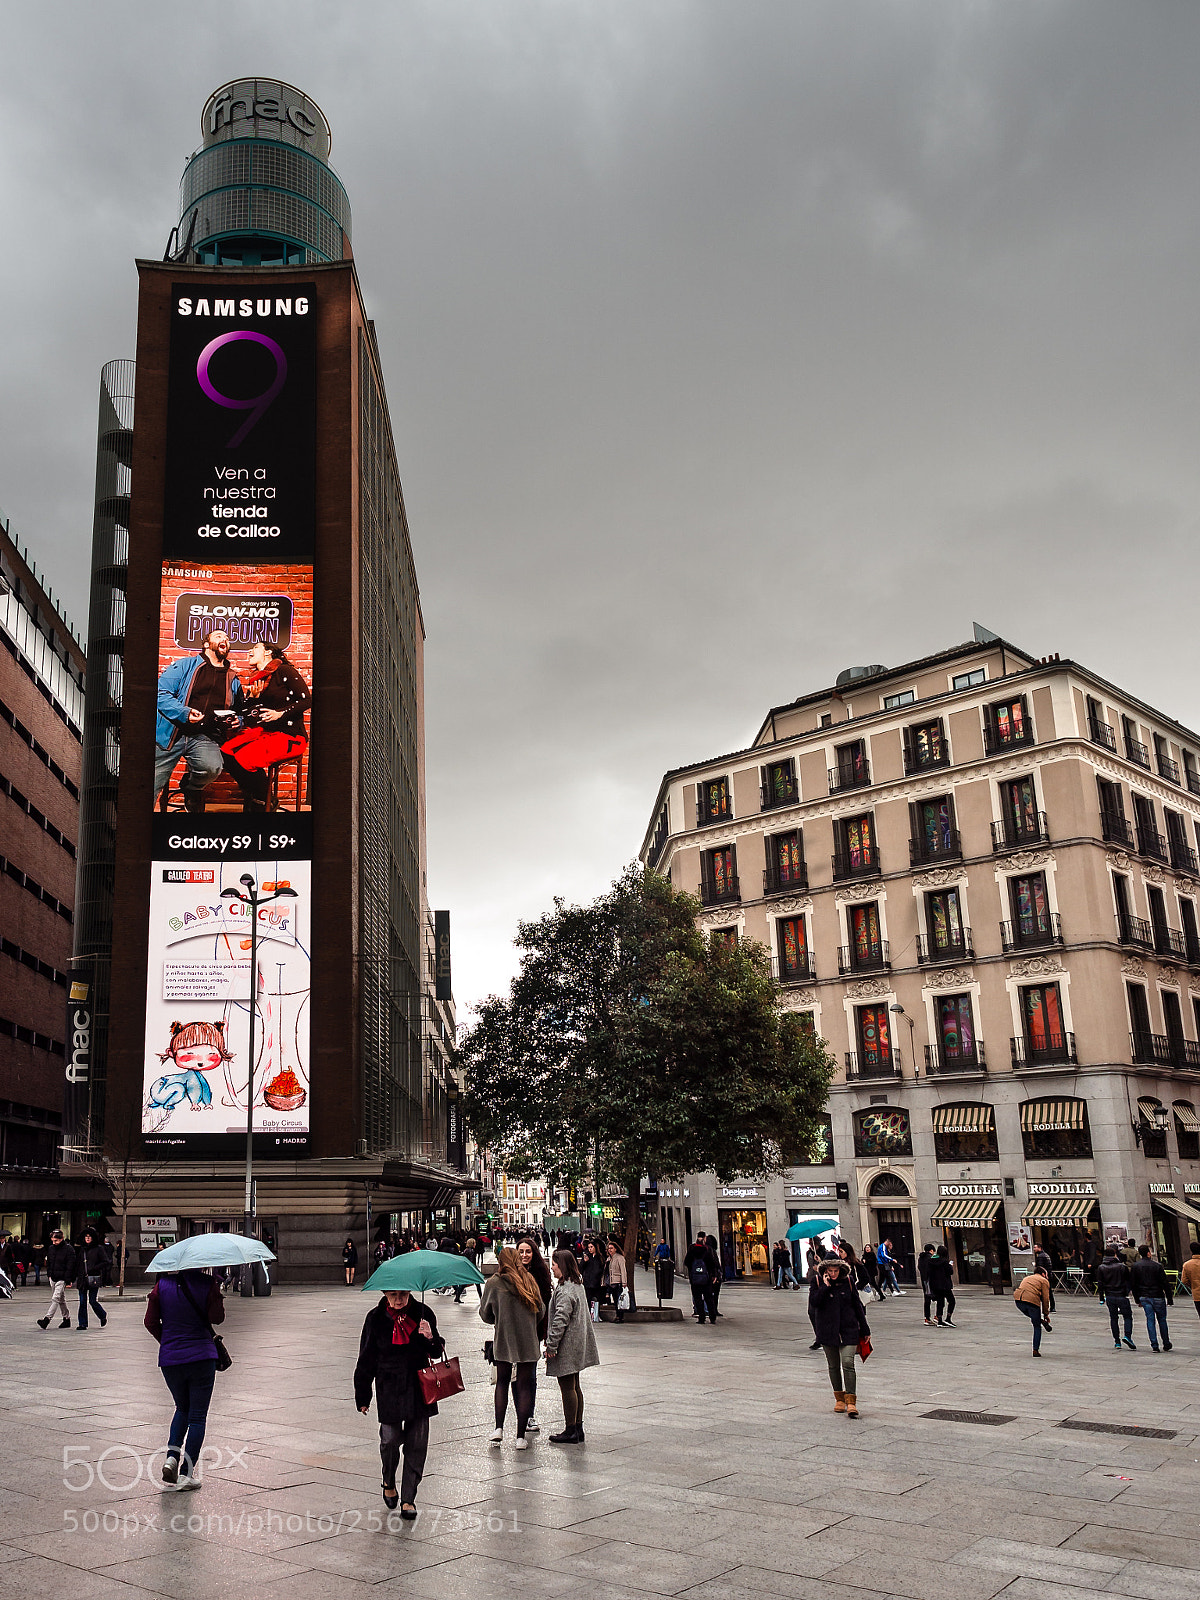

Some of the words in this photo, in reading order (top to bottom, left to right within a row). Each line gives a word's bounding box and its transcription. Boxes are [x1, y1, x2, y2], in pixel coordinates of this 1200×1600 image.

[210, 92, 316, 136] fnac
[177, 297, 309, 316] SAMSUNG
[214, 466, 249, 480] Ven
[254, 468, 266, 480] a
[203, 485, 276, 499] nuestra
[211, 504, 268, 518] tienda
[197, 524, 221, 538] de
[225, 524, 281, 538] Callao
[161, 567, 213, 579] SAMSUNG
[189, 605, 280, 618] SLOW-MO
[188, 615, 280, 644] POPCORN
[168, 835, 230, 853] Galaxy
[232, 835, 252, 849] S9
[269, 835, 296, 849] S9+
[168, 904, 222, 932] BABY
[437, 933, 450, 978] fnac
[65, 1009, 90, 1084] fnac
[944, 1125, 978, 1133] RODILLA
[1033, 1123, 1071, 1131] RODILLA
[940, 1184, 1001, 1195] RODILLA
[1029, 1183, 1095, 1195] RODILLA
[943, 1220, 980, 1228] RODILLA
